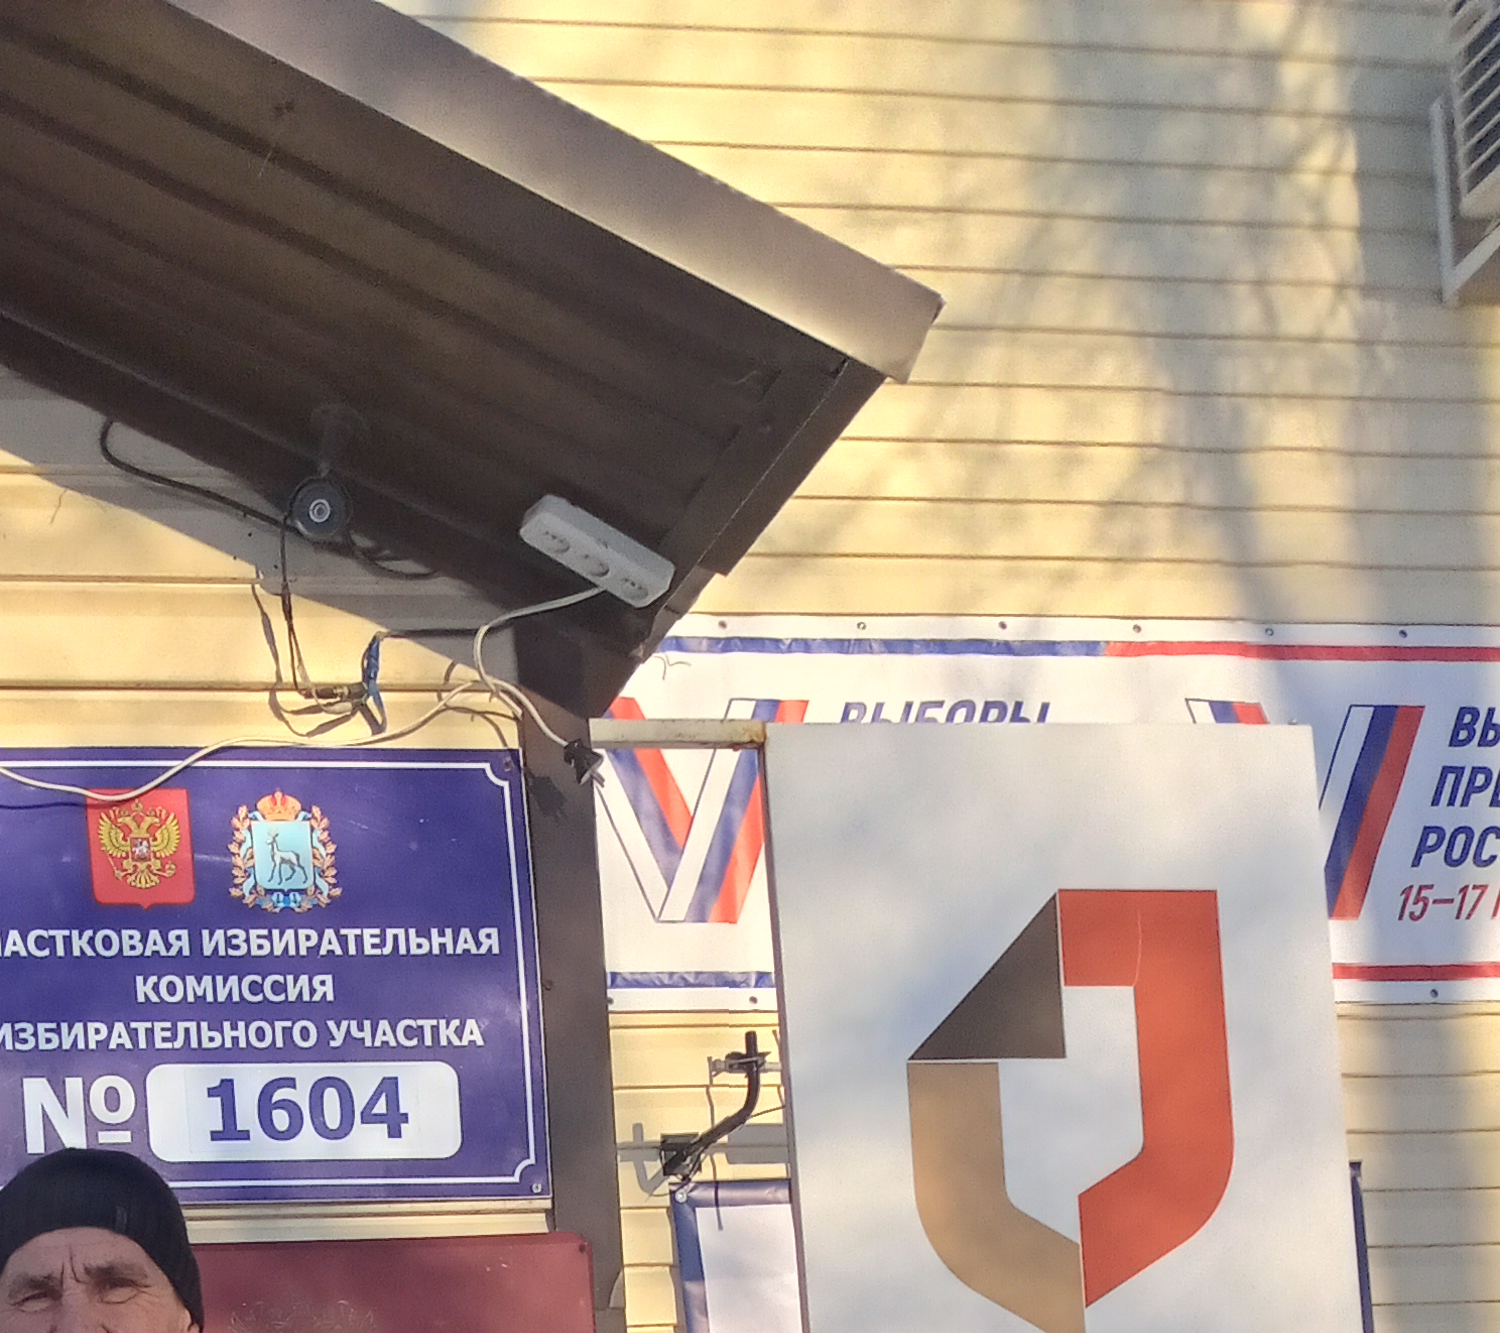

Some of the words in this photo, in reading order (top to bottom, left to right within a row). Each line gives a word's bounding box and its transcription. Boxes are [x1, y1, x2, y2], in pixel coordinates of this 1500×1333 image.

[201, 927, 500, 957] ИЗБИРАТЕЛЬНАЯ
[135, 974, 335, 1004] КОМИССИЯ
[328, 1018, 484, 1049] УЧАСТКА
[205, 1076, 409, 1143] 1604
